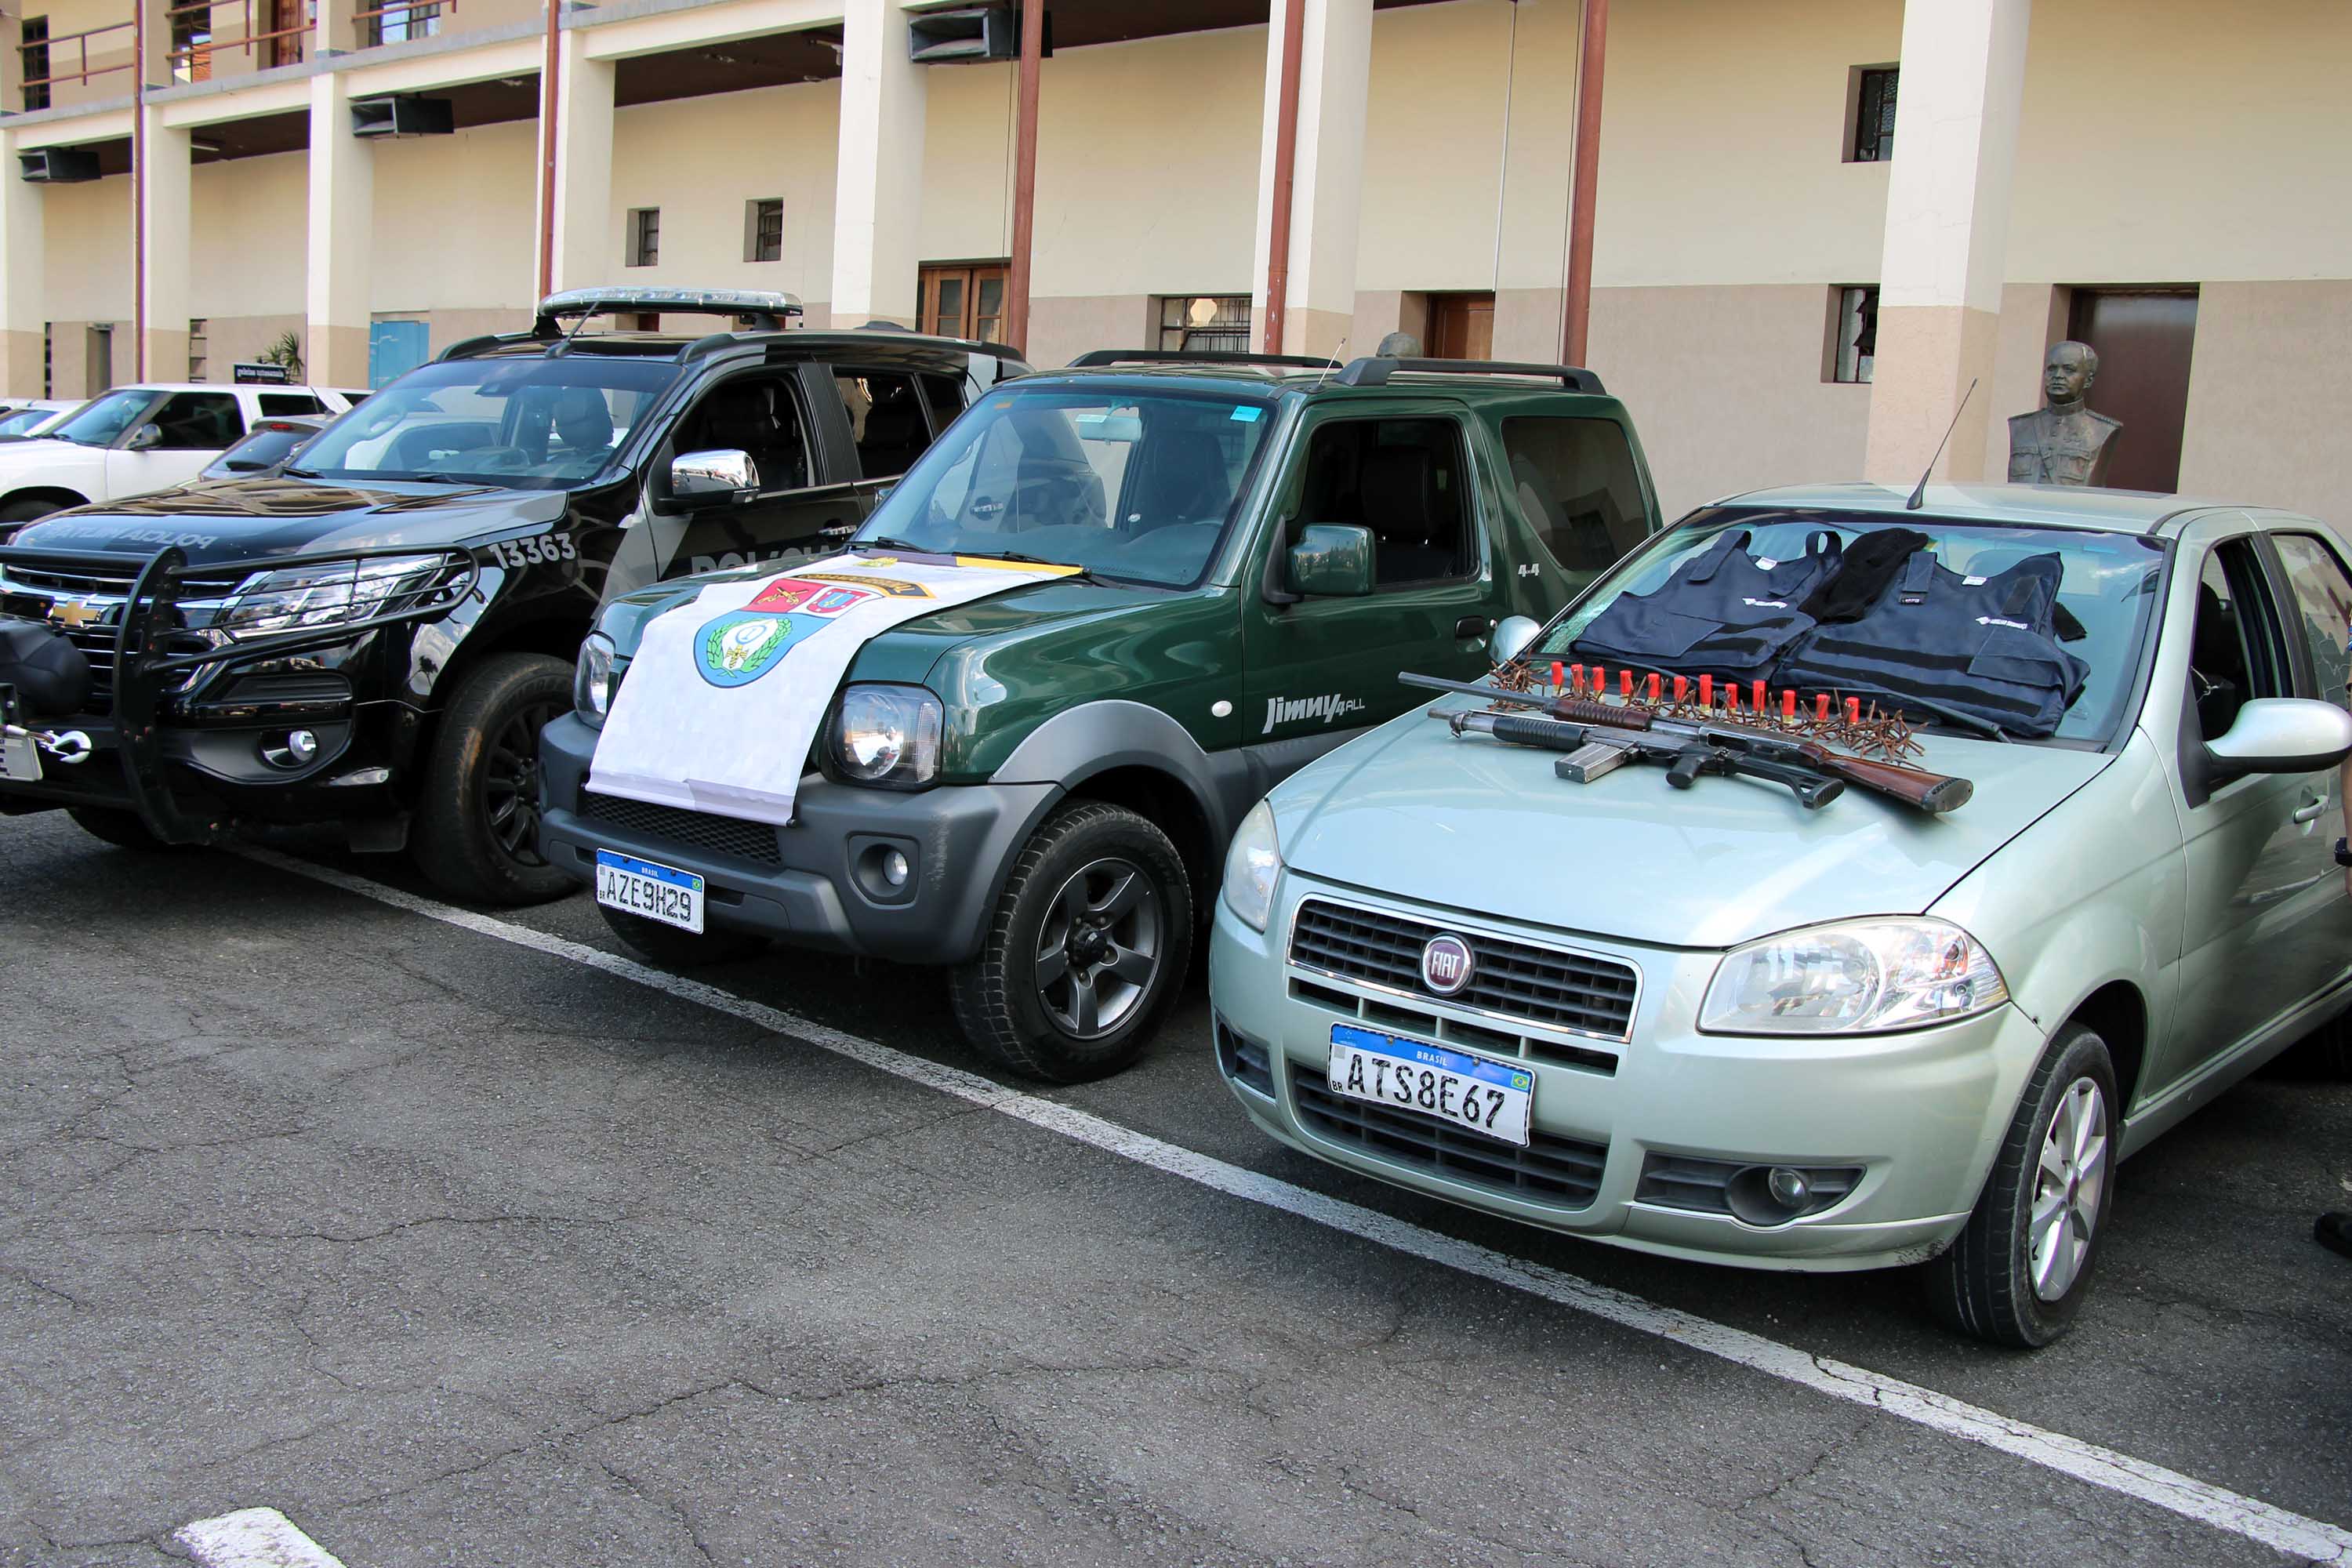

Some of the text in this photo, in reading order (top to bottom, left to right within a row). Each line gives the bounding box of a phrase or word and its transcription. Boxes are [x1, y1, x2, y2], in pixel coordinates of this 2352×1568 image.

[488, 533, 576, 569] 13363
[641, 866, 659, 877] BRASIL
[607, 871, 691, 922] AZE9H29
[1431, 950, 1461, 979] FIAT
[1417, 1051, 1448, 1066] BRASIL
[1332, 1080, 1344, 1093] BR
[1348, 1054, 1505, 1130] ATS8E67
